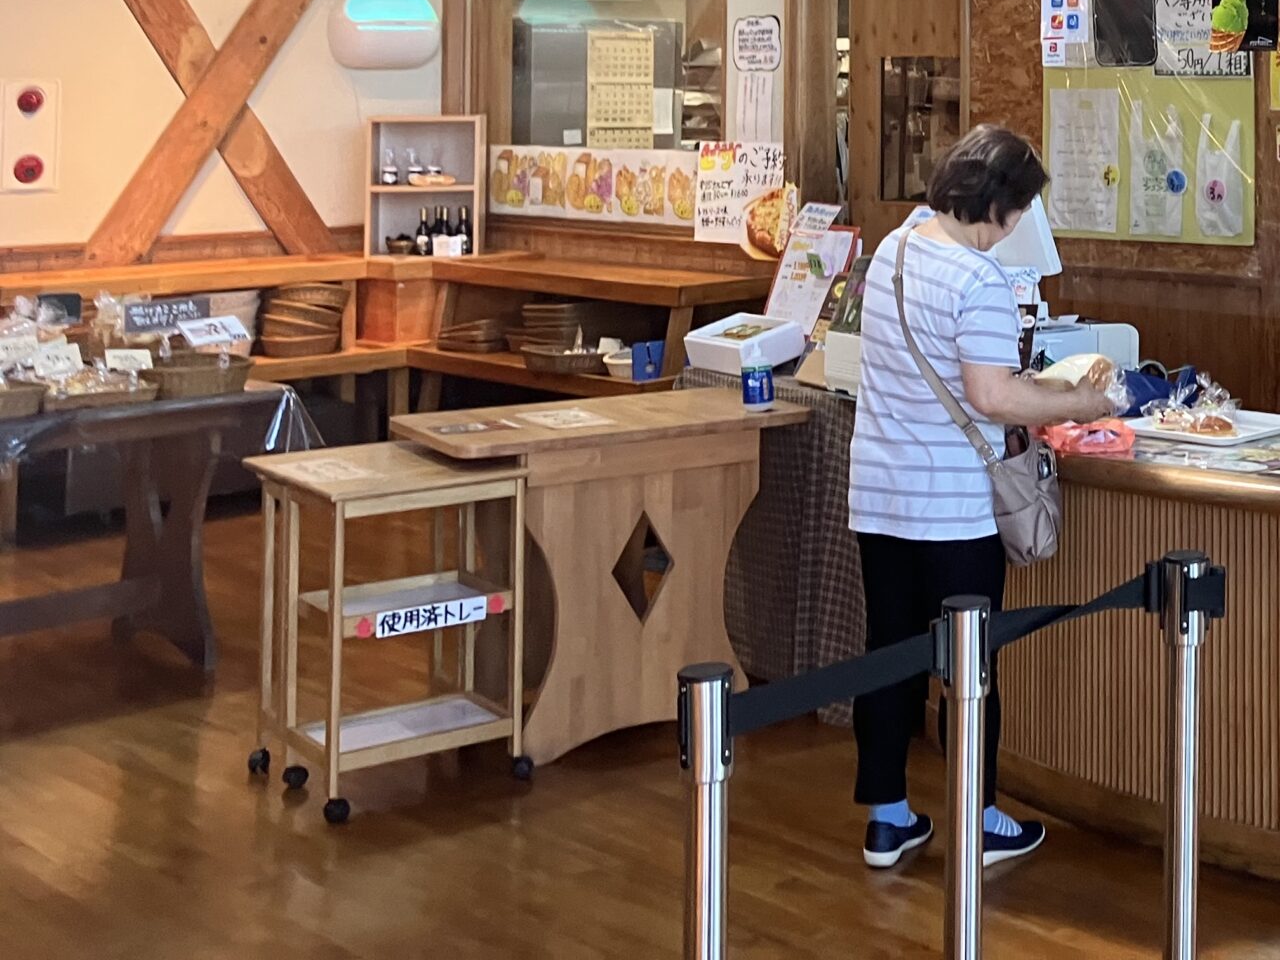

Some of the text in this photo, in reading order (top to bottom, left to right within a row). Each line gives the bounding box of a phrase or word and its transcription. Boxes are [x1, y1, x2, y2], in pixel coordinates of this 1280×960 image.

[379, 603, 485, 636] 使用済トレー
